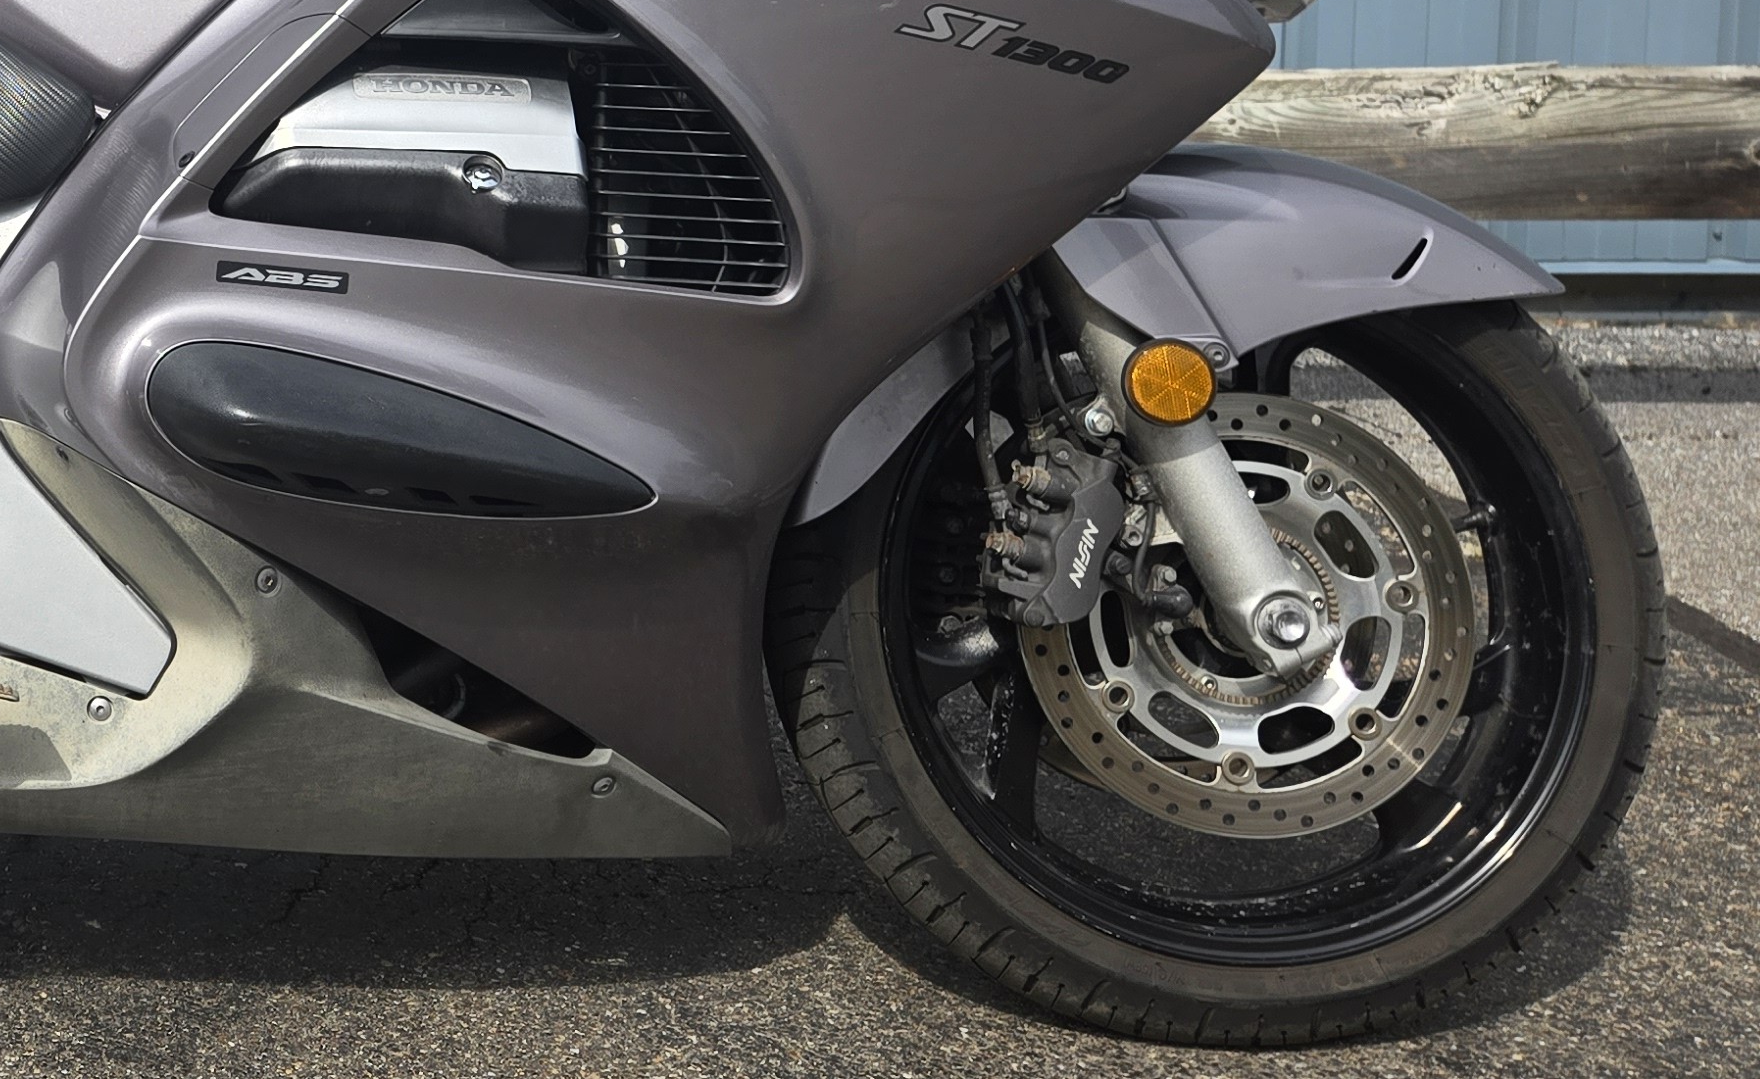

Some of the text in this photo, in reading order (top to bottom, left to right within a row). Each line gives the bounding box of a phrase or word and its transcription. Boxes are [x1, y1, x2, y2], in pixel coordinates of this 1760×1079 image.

[370, 75, 515, 97] HONDA
[220, 266, 344, 289] ABS
[1068, 518, 1100, 590] NISSIN
